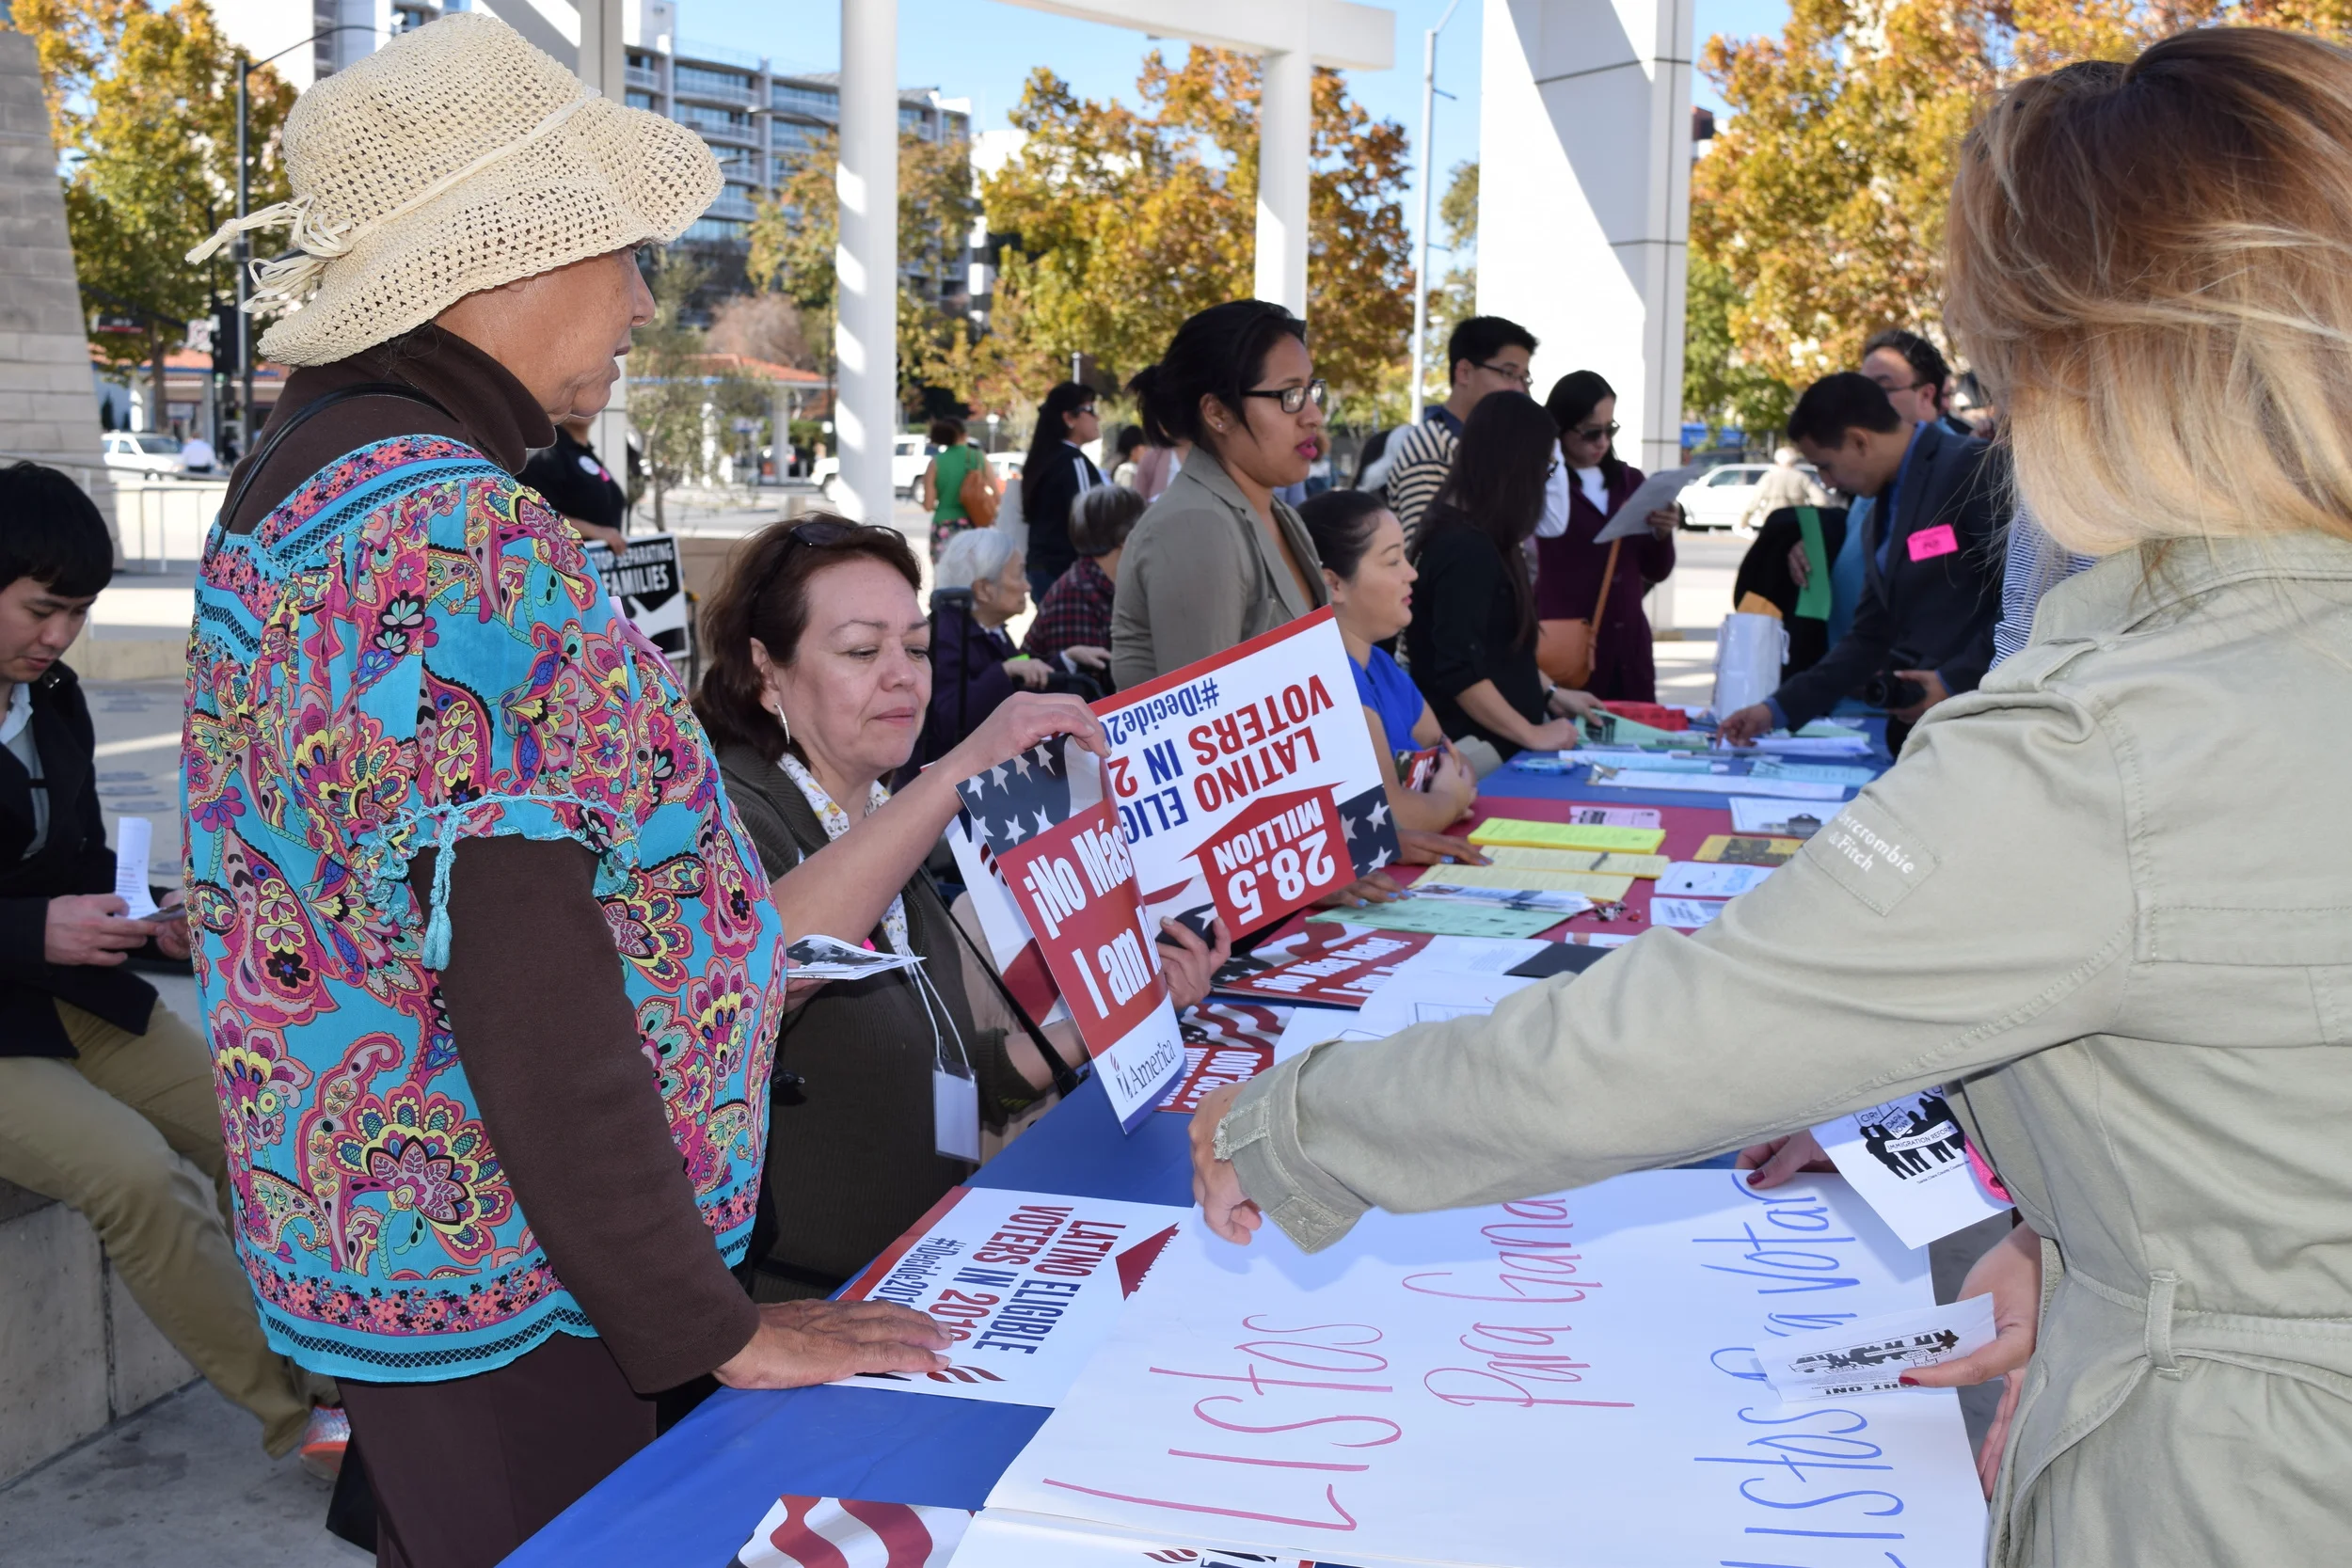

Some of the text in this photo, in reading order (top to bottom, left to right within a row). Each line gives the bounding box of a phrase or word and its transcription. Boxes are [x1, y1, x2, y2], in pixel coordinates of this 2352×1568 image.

[601, 564, 670, 596] FAMILIES
[1188, 674, 1335, 766] VOTERS
[1143, 738, 1184, 785] IN
[1193, 726, 1320, 812] LATINO
[1212, 798, 1324, 875] MILLION
[1837, 807, 1915, 874] bercrombie
[1228, 829, 1335, 926] 28.5
[1072, 948, 1110, 1019] I
[1098, 927, 1152, 1006] am
[1887, 1124, 1955, 1150] IMMIGRATION REFORM
[972, 1205, 1075, 1266] VOTERS
[872, 1237, 968, 1308] #iDecide201
[953, 1267, 1019, 1289] IN
[972, 1220, 1127, 1354] LATINO ELIGIBLE
